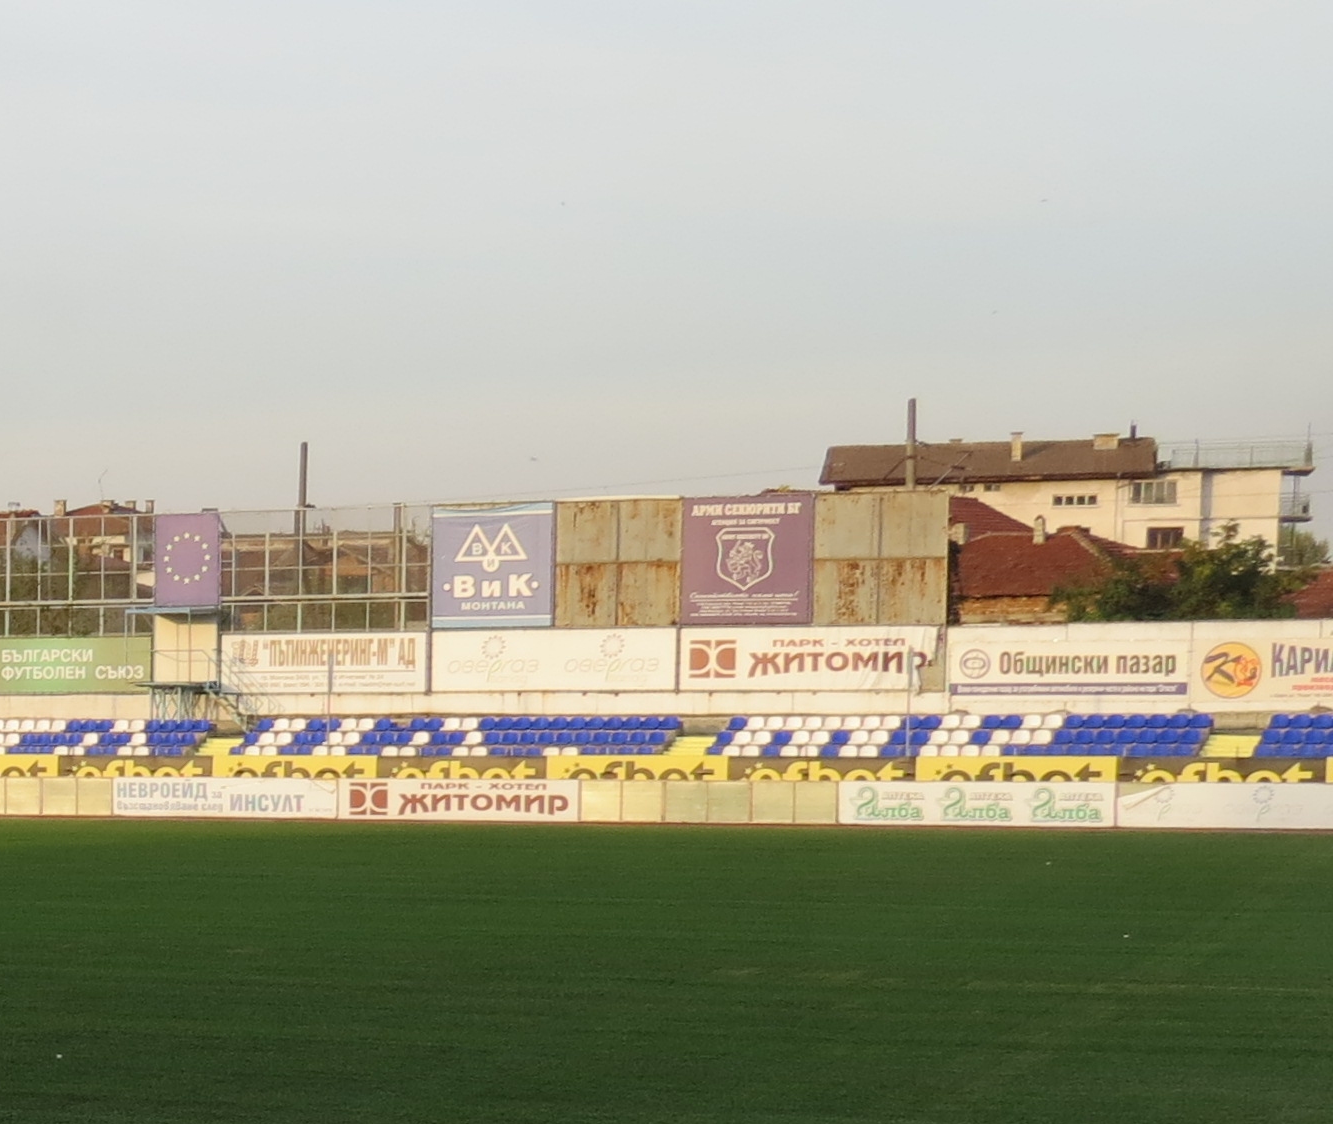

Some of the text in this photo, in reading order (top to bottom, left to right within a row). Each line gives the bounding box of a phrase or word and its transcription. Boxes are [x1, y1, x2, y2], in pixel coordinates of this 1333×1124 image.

[461, 601, 525, 610] МОНТАНА
[773, 639, 825, 648] ПАРК
[845, 638, 905, 647] ХОТЕЛ
[2, 650, 93, 662] БЪЛГАРСКИ
[398, 638, 415, 668] АД
[1271, 642, 1333, 678] КАРИ
[1, 665, 144, 680] ФУТБОЛЕН СЪЮЗ
[999, 651, 1176, 676] Общински пазар
[117, 779, 208, 801] НЕВРОЕЙД
[421, 782, 469, 790] ПАРК
[489, 782, 547, 790] ХОТЕЛ
[230, 794, 304, 813] ИНСУЛТ
[398, 794, 568, 815] ЖИТОМИР
